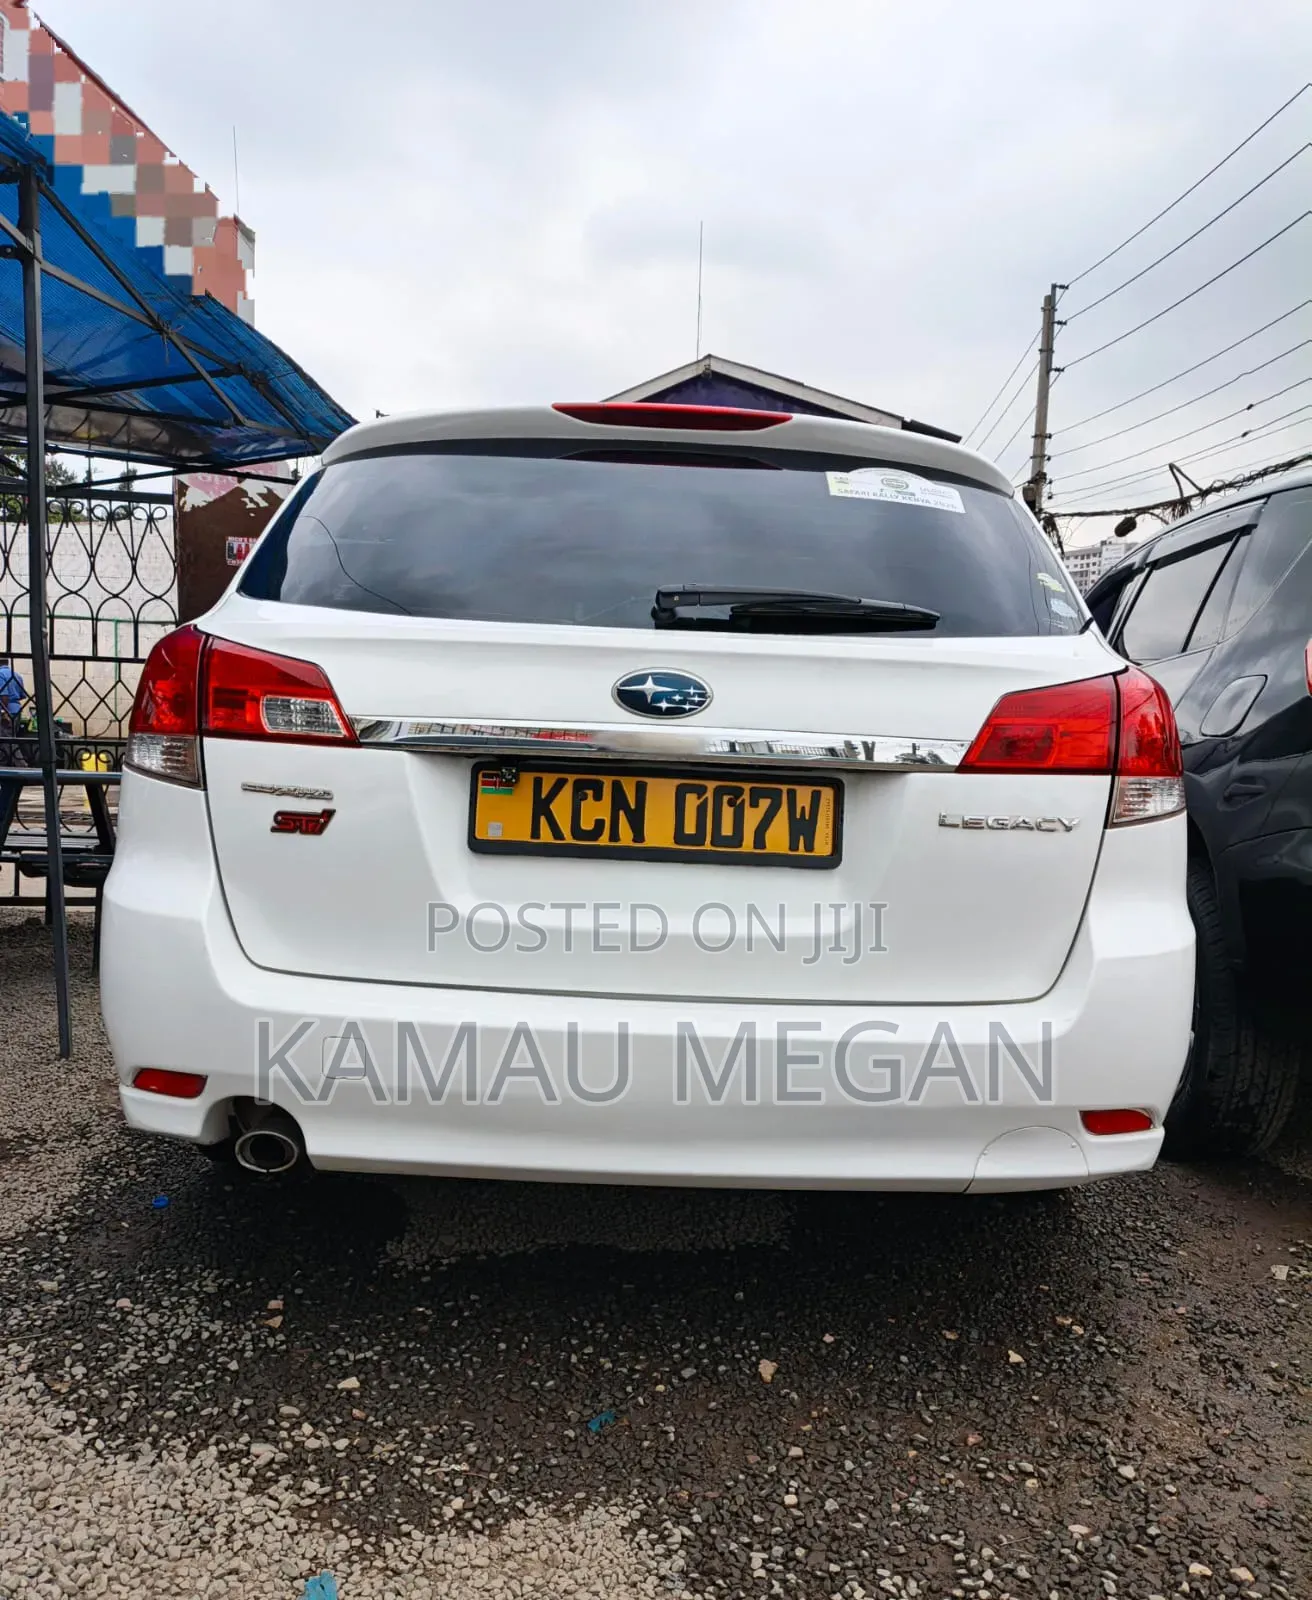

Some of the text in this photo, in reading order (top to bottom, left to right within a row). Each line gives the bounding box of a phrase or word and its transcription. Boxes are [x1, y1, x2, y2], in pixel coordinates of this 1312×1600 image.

[837, 488, 870, 497] SAFARI
[872, 491, 900, 500] RALLY
[901, 495, 932, 505] KENYA
[530, 776, 648, 843] KCN
[674, 782, 822, 852] 007W
[938, 811, 1080, 832] LEGACY
